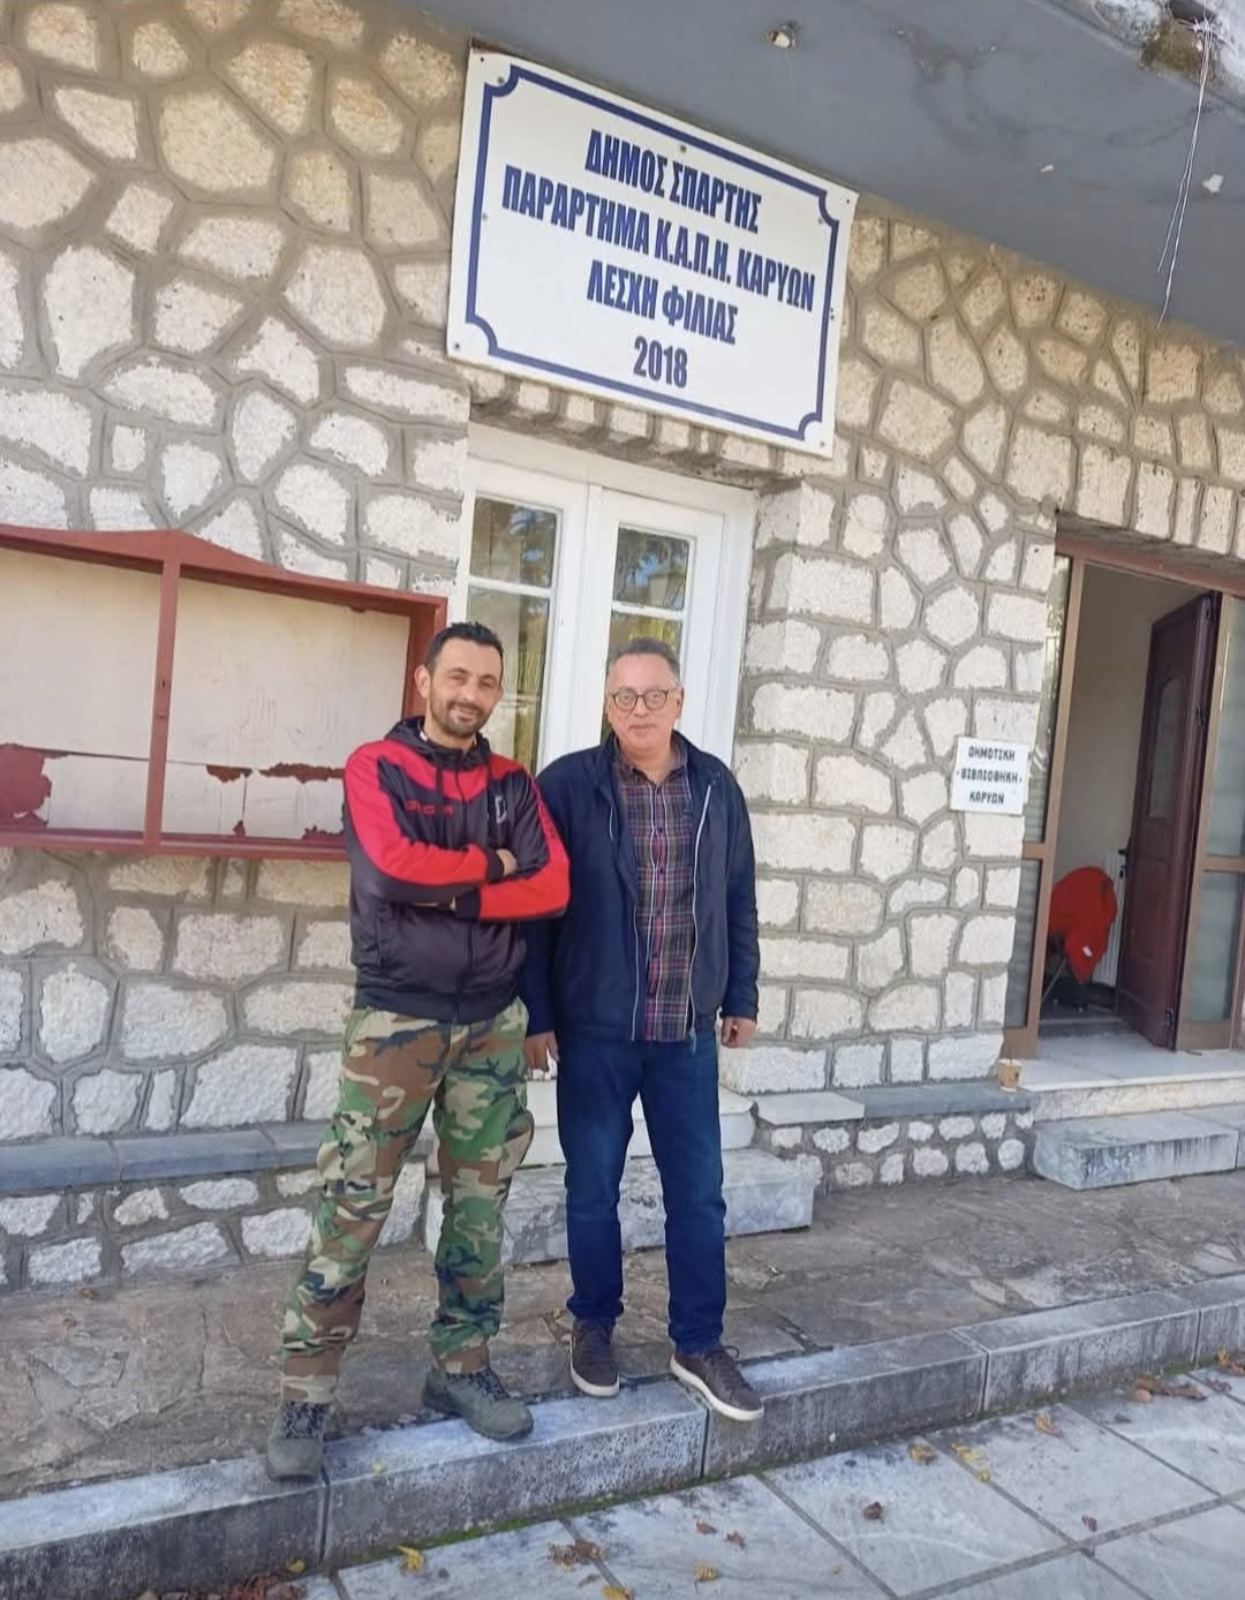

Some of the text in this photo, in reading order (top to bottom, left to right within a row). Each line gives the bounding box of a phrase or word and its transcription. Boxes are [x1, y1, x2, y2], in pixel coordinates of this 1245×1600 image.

[585, 129, 762, 234] ΔΗΜΟΣ ΣΠΑΡΤΗΣ
[502, 165, 815, 312] ΠΑΡΑΡΤΗΜΑ Κ.Α.Π.Η. ΚΑΡΥΩΝ
[587, 260, 738, 345] ΛΕΣΧΗ ΦΙΛΙΑΣ
[633, 336, 688, 388] 2018
[969, 791, 1005, 805] ΚΑΡΥΩΝ
